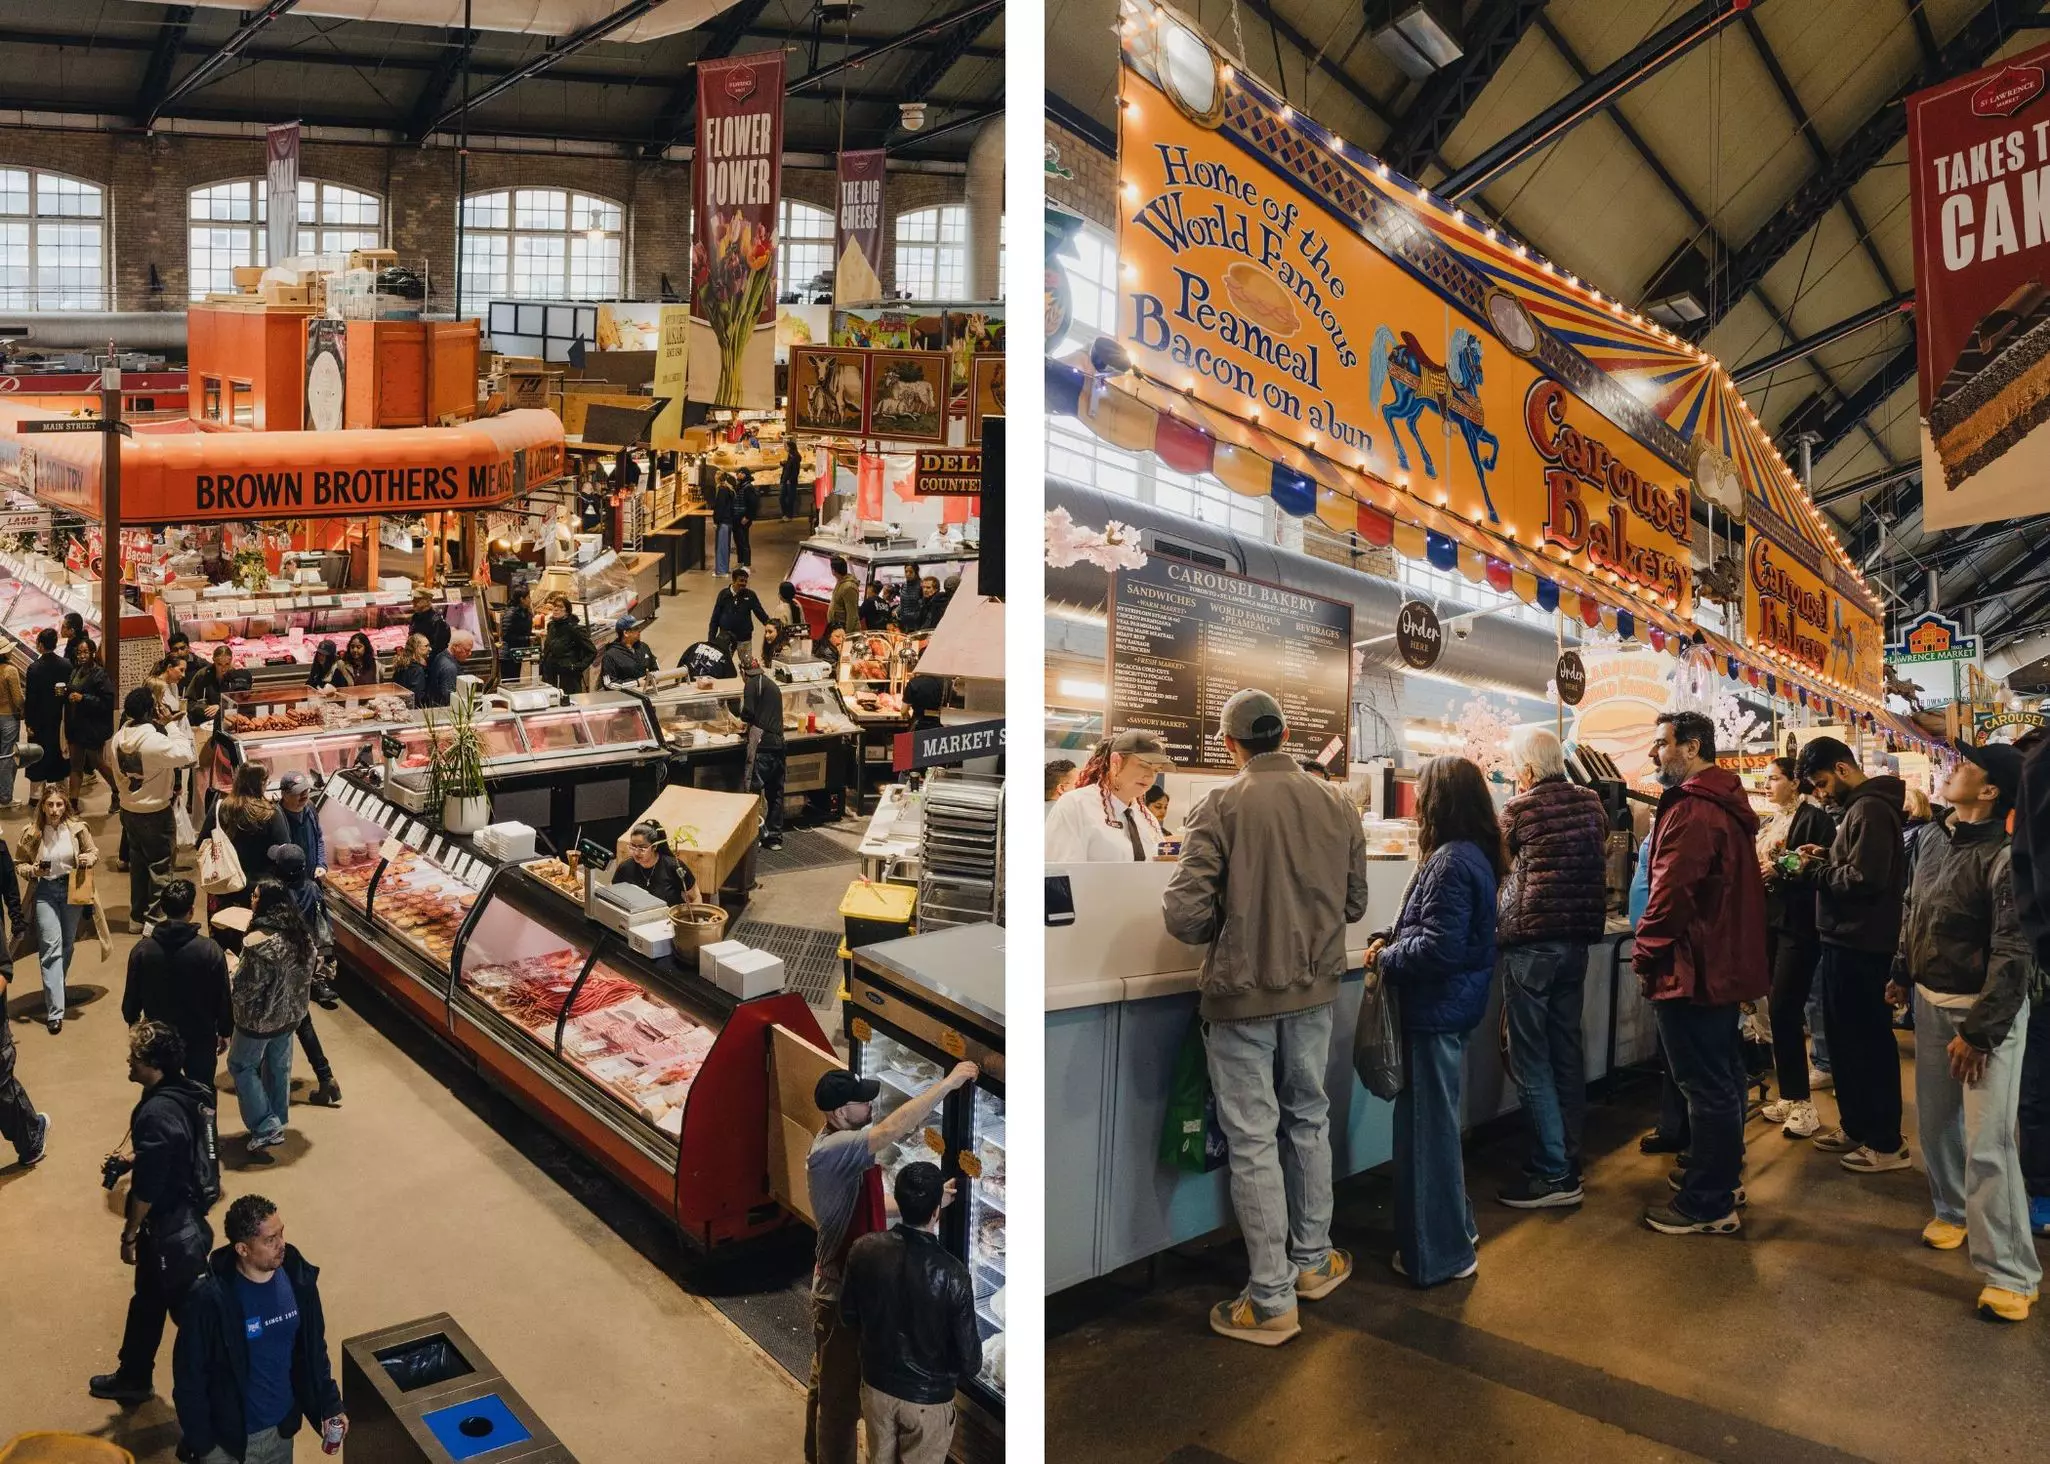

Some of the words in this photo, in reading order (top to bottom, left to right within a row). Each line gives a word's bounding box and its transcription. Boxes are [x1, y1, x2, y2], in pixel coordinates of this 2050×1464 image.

[1990, 81, 2036, 104] LAWRENCE
[1996, 96, 2020, 109] MARKET
[706, 112, 772, 158] FLOWER
[1934, 130, 2025, 195] TAKES
[706, 158, 770, 206] POWER
[841, 181, 860, 204] THE
[862, 180, 880, 204] BIG
[841, 204, 878, 230] CHEESE
[1154, 144, 1257, 206] Home
[1262, 198, 1299, 238] of
[1300, 228, 1345, 299] the
[1132, 192, 1254, 258] World
[1258, 222, 1357, 369] Famous
[1173, 266, 1322, 392] Peameal
[1128, 293, 1258, 398] Bacon
[1262, 382, 1302, 421] on
[42, 422, 64, 431] MAIN
[66, 422, 96, 430] STREET
[1524, 376, 1691, 547] Carousel
[46, 460, 84, 496] POULTRY
[196, 472, 302, 510] BROWN
[314, 466, 458, 505] BROTHERS
[468, 460, 511, 498] MEATS
[1542, 466, 1692, 611] Bakery
[127, 546, 152, 563] Bacon
[1127, 584, 1196, 608] SANDWICHES
[1168, 564, 1256, 598] CAROUSEL
[1262, 588, 1317, 613] BAKERY
[1189, 586, 1216, 597] TORONTO
[1749, 534, 1829, 634] Carousel
[1140, 600, 1158, 608] WARM
[1160, 604, 1186, 614] MARKET
[1210, 602, 1244, 618] WORLD
[1246, 612, 1281, 626] FAMOUS
[1226, 616, 1266, 632] PEAMEAL
[1296, 622, 1340, 639] BEVERAGES
[1402, 610, 1440, 642] Order
[1758, 593, 1828, 674] Bakery
[1410, 640, 1429, 652] HERE
[1890, 650, 1935, 664] LAWRENCE
[1938, 649, 1974, 659] MARKET
[1136, 657, 1157, 666] FRESH
[1158, 660, 1182, 669] MARKET
[1560, 660, 1584, 682] Order
[1129, 716, 1159, 726] SAVOURY
[1160, 720, 1186, 729] MARKET
[1984, 713, 2047, 730] CAROUSEL
[923, 730, 994, 757] MARKET
[265, 1316, 283, 1326] SINCE
